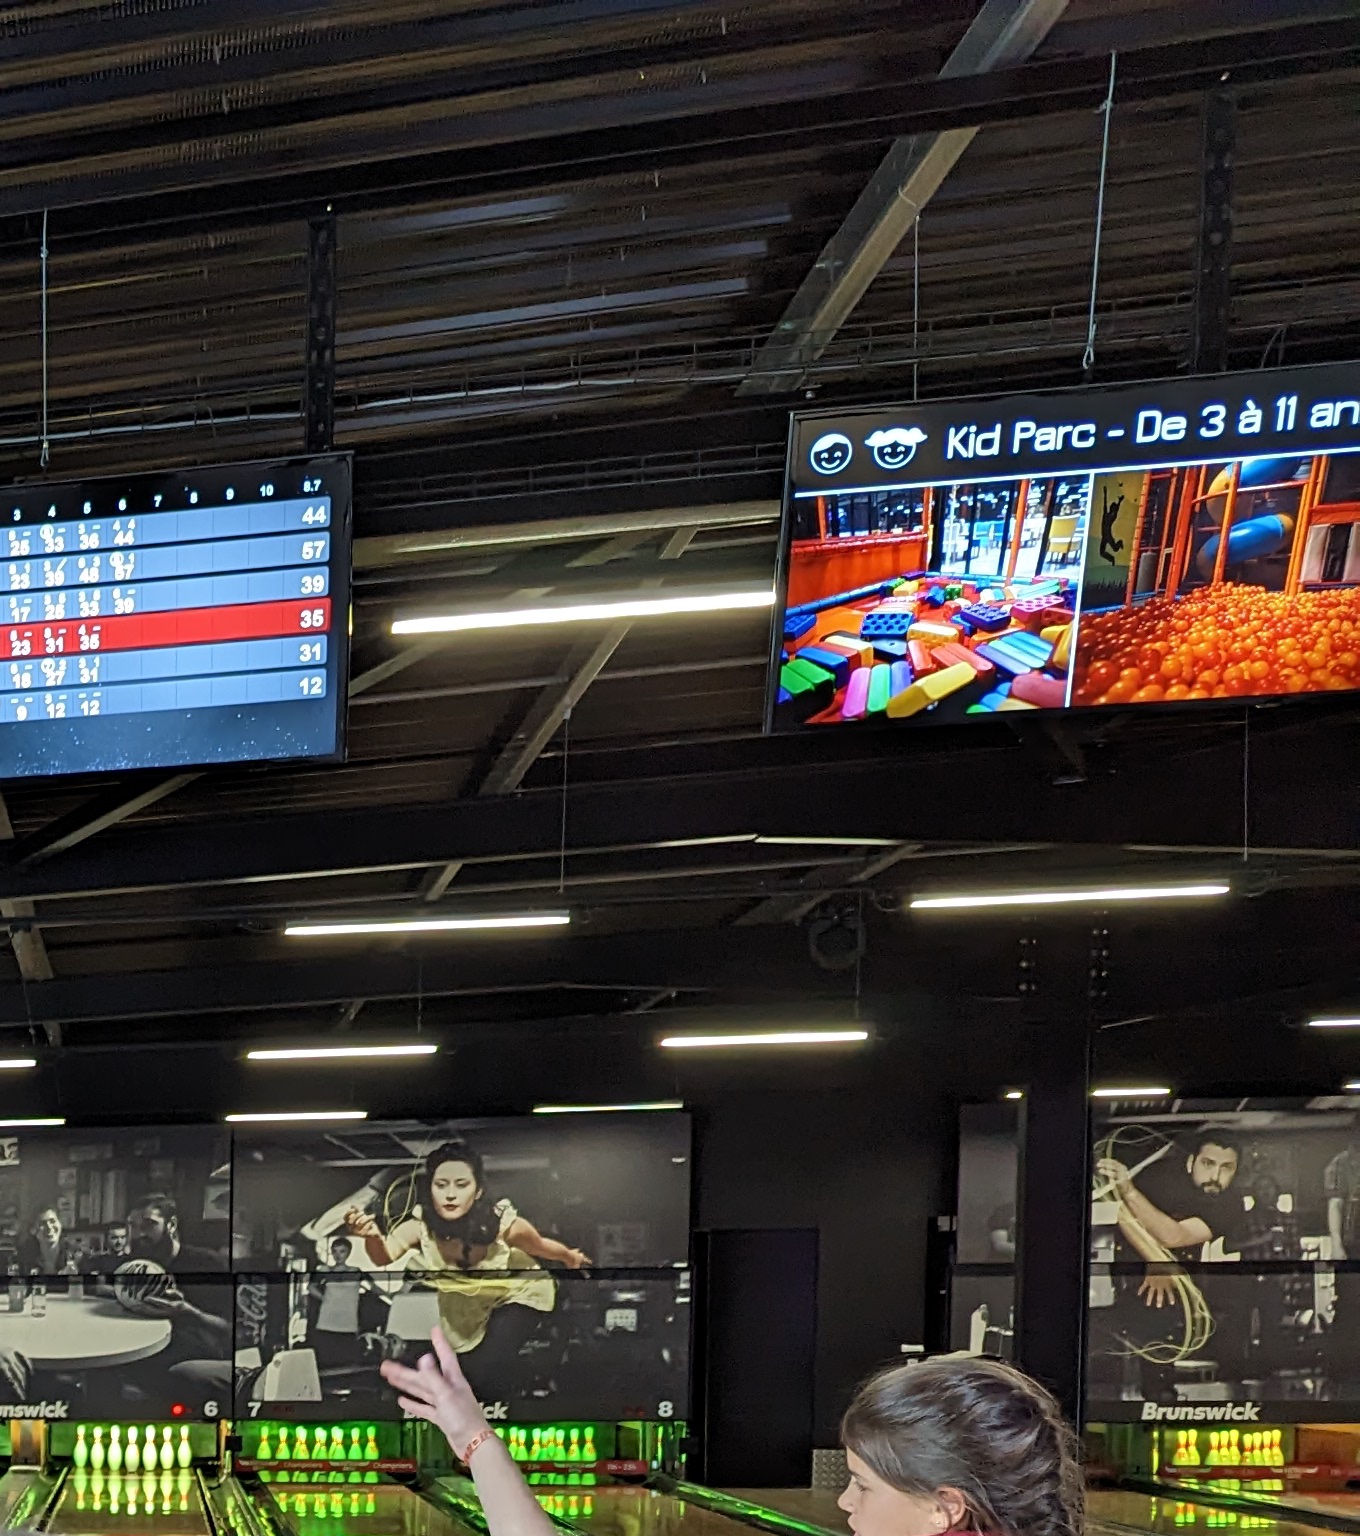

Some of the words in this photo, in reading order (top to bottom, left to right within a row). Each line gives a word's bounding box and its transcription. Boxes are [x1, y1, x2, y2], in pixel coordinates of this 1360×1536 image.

[947, 424, 1000, 459] Kid
[1013, 421, 1096, 453] Parc
[1136, 410, 1186, 445] De
[1199, 405, 1224, 438] 3
[1239, 401, 1262, 434] à
[1275, 397, 1295, 431] 11
[13, 509, 21, 521] 3
[48, 505, 56, 517] 4
[154, 495, 162, 508] 7
[226, 488, 234, 501] 9
[260, 484, 274, 497] 10
[303, 479, 321, 493] 8.7
[114, 530, 134, 546] 44
[302, 506, 326, 525] 44
[302, 541, 325, 560] 57
[12, 607, 30, 622] 17
[301, 575, 325, 594] 39
[12, 640, 31, 656] 23
[46, 637, 64, 653] 31
[299, 610, 325, 628] 35
[80, 667, 98, 683] 31
[299, 643, 323, 662] 31
[47, 702, 65, 719] 12
[81, 700, 100, 716] 12
[299, 677, 323, 696] 12
[204, 1401, 218, 1416] 6
[248, 1402, 260, 1416] 7
[658, 1401, 673, 1417] 8
[1141, 1402, 1261, 1421] Brunswick
